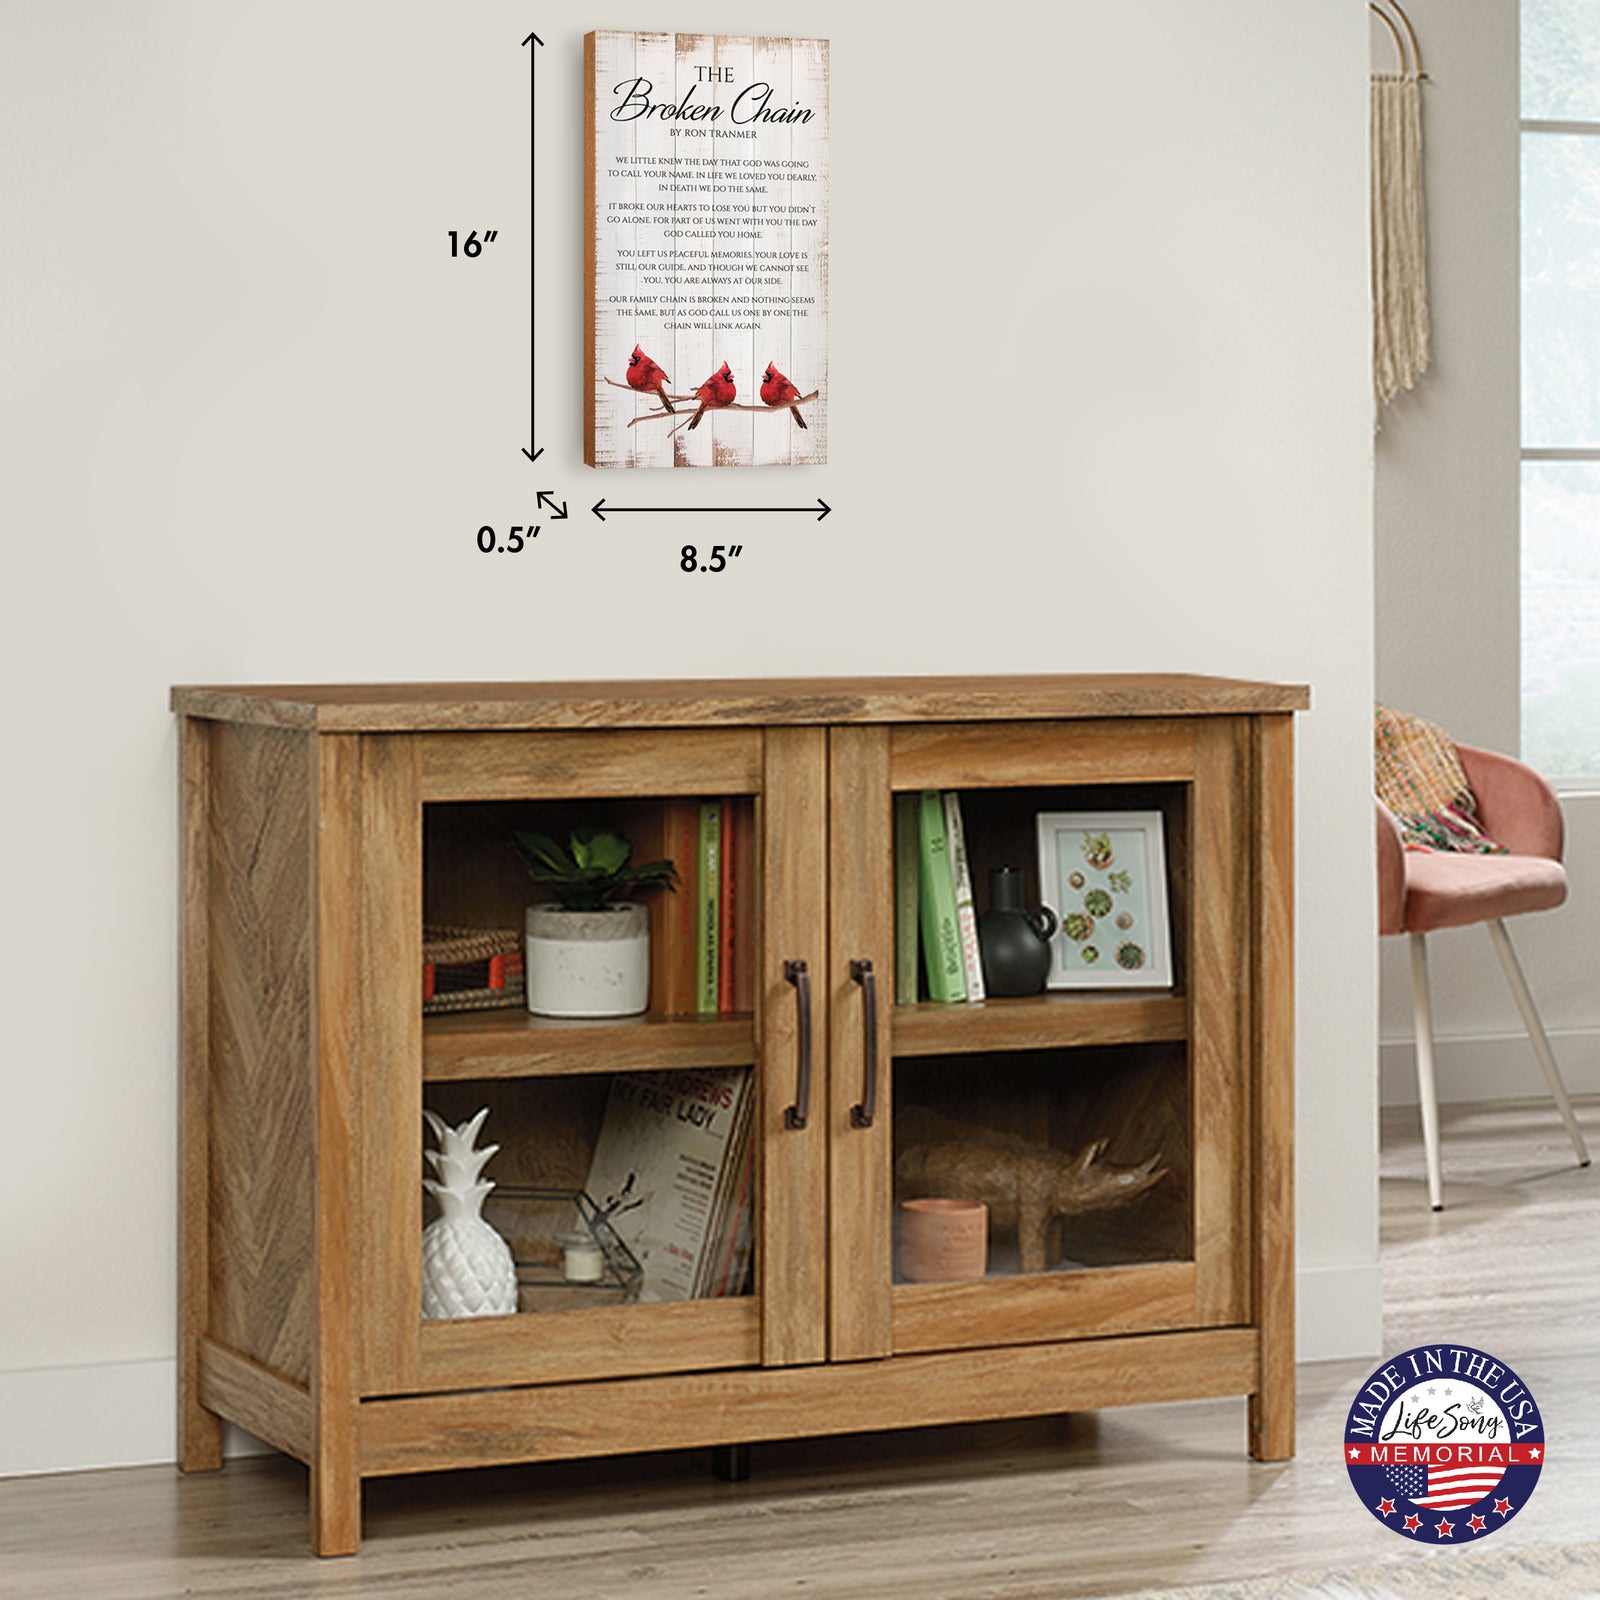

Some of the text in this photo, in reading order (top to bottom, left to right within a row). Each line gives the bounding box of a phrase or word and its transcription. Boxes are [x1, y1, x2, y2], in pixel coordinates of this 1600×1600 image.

[694, 66, 734, 82] THE
[610, 77, 815, 124] Broken Chain
[684, 129, 706, 137] RON
[709, 130, 757, 139] TRANMER
[631, 157, 656, 165] LITTLE
[743, 159, 762, 167] GOD
[782, 160, 809, 168] GOING
[621, 170, 642, 178] CALL
[725, 172, 737, 180] WE
[739, 172, 766, 180] LOVED
[670, 184, 697, 192] DEATH
[647, 203, 664, 211] OUR
[712, 204, 730, 212] LOSE
[769, 205, 787, 213] YOU
[693, 217, 704, 225] OF
[705, 217, 715, 225] US
[765, 218, 783, 226] YOU
[685, 230, 716, 238] CALLED
[637, 250, 656, 258] LEFT
[708, 264, 744, 272] THOUGH
[746, 264, 758, 272] WE
[702, 277, 732, 285] ALWAYS
[733, 277, 744, 285] AT
[698, 296, 729, 304] BROKEN
[731, 296, 750, 304] AND
[660, 309, 676, 317] BUT
[677, 309, 687, 317] AS
[688, 309, 708, 317] GOD
[709, 309, 730, 317] CALL
[732, 309, 741, 317] US
[664, 322, 692, 330] CHAIN
[694, 322, 713, 330] WILL
[715, 322, 733, 330] LINK
[677, 1100, 718, 1130] LADY
